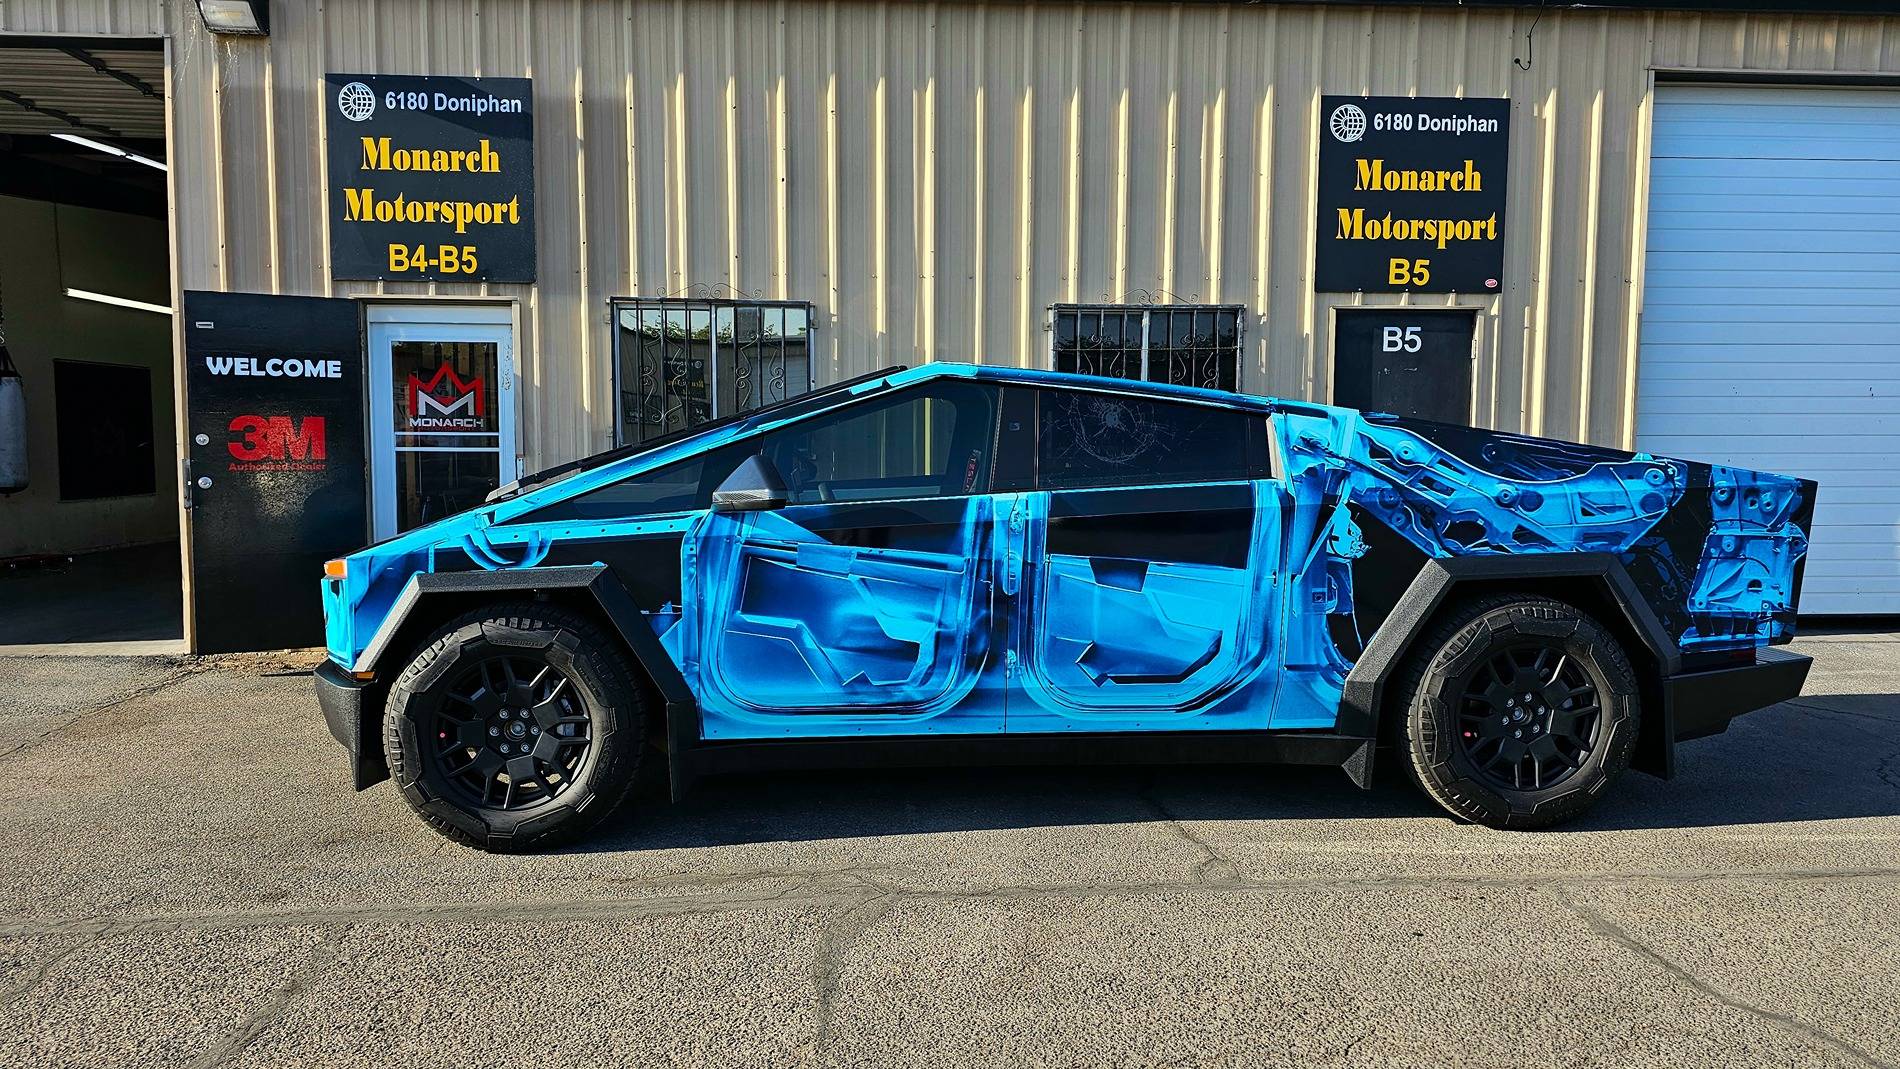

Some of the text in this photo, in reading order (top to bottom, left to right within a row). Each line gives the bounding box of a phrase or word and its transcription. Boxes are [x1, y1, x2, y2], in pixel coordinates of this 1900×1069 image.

[385, 91, 522, 117] 6180 Doniphan
[1373, 113, 1498, 136] 6180 Doniphan
[361, 136, 501, 173] Monarch
[1354, 158, 1482, 192] Monarch
[343, 188, 521, 234] Motorsport
[1335, 207, 1498, 250] Motorsport
[388, 243, 478, 274] B4-B5
[1388, 257, 1430, 286] B5
[1382, 326, 1422, 353] B5
[205, 356, 342, 379] WELCOME
[227, 415, 326, 460] 3M
[409, 418, 484, 428] MONARCH
[228, 462, 326, 471] Authorized Dealer
